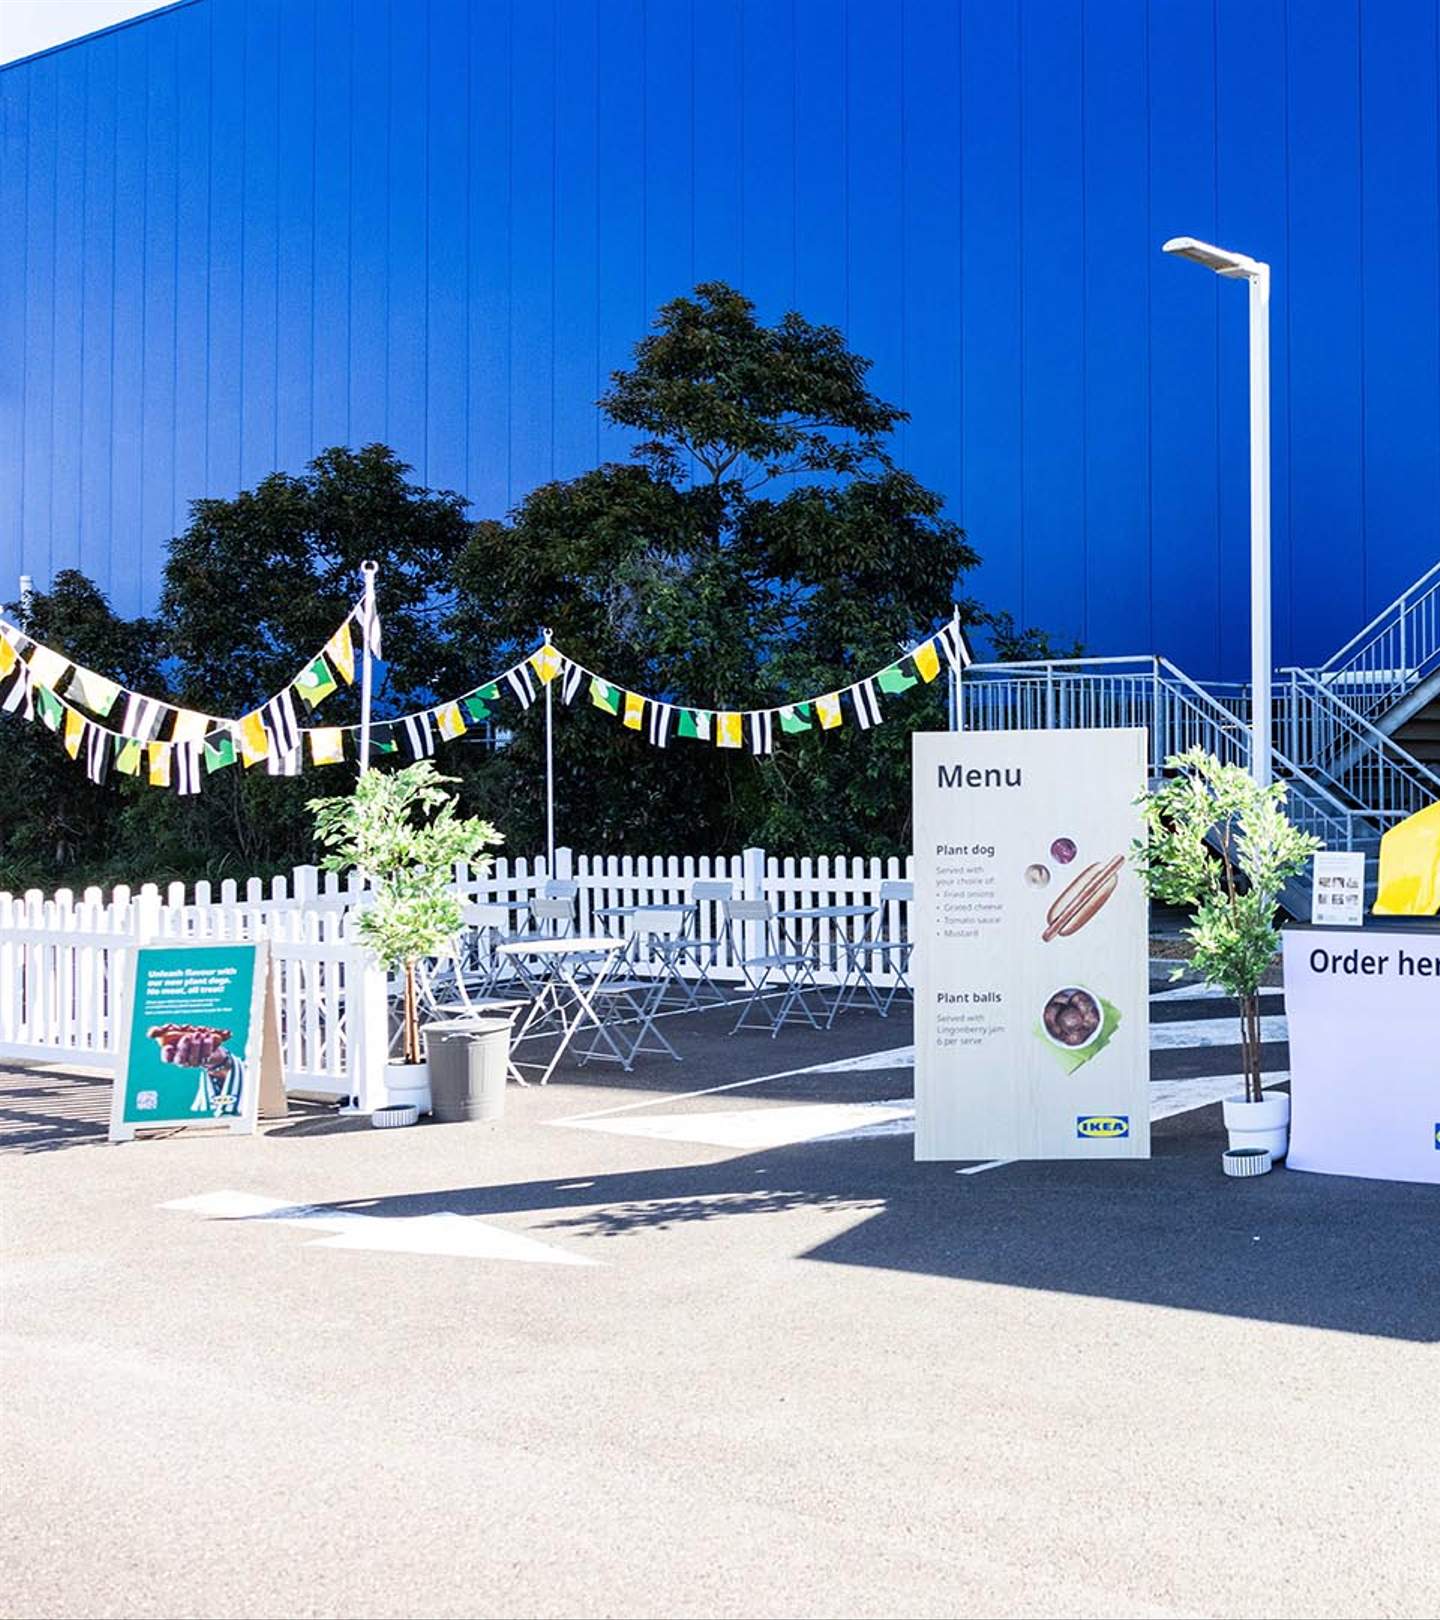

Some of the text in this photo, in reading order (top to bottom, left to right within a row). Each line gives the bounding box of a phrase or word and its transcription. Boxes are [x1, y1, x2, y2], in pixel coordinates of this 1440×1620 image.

[938, 765, 1021, 788] Menu
[936, 843, 995, 858] Plant dog
[1310, 949, 1389, 975] Order
[937, 991, 1002, 1003] Plant balls
[1083, 1122, 1124, 1131] IKEA
